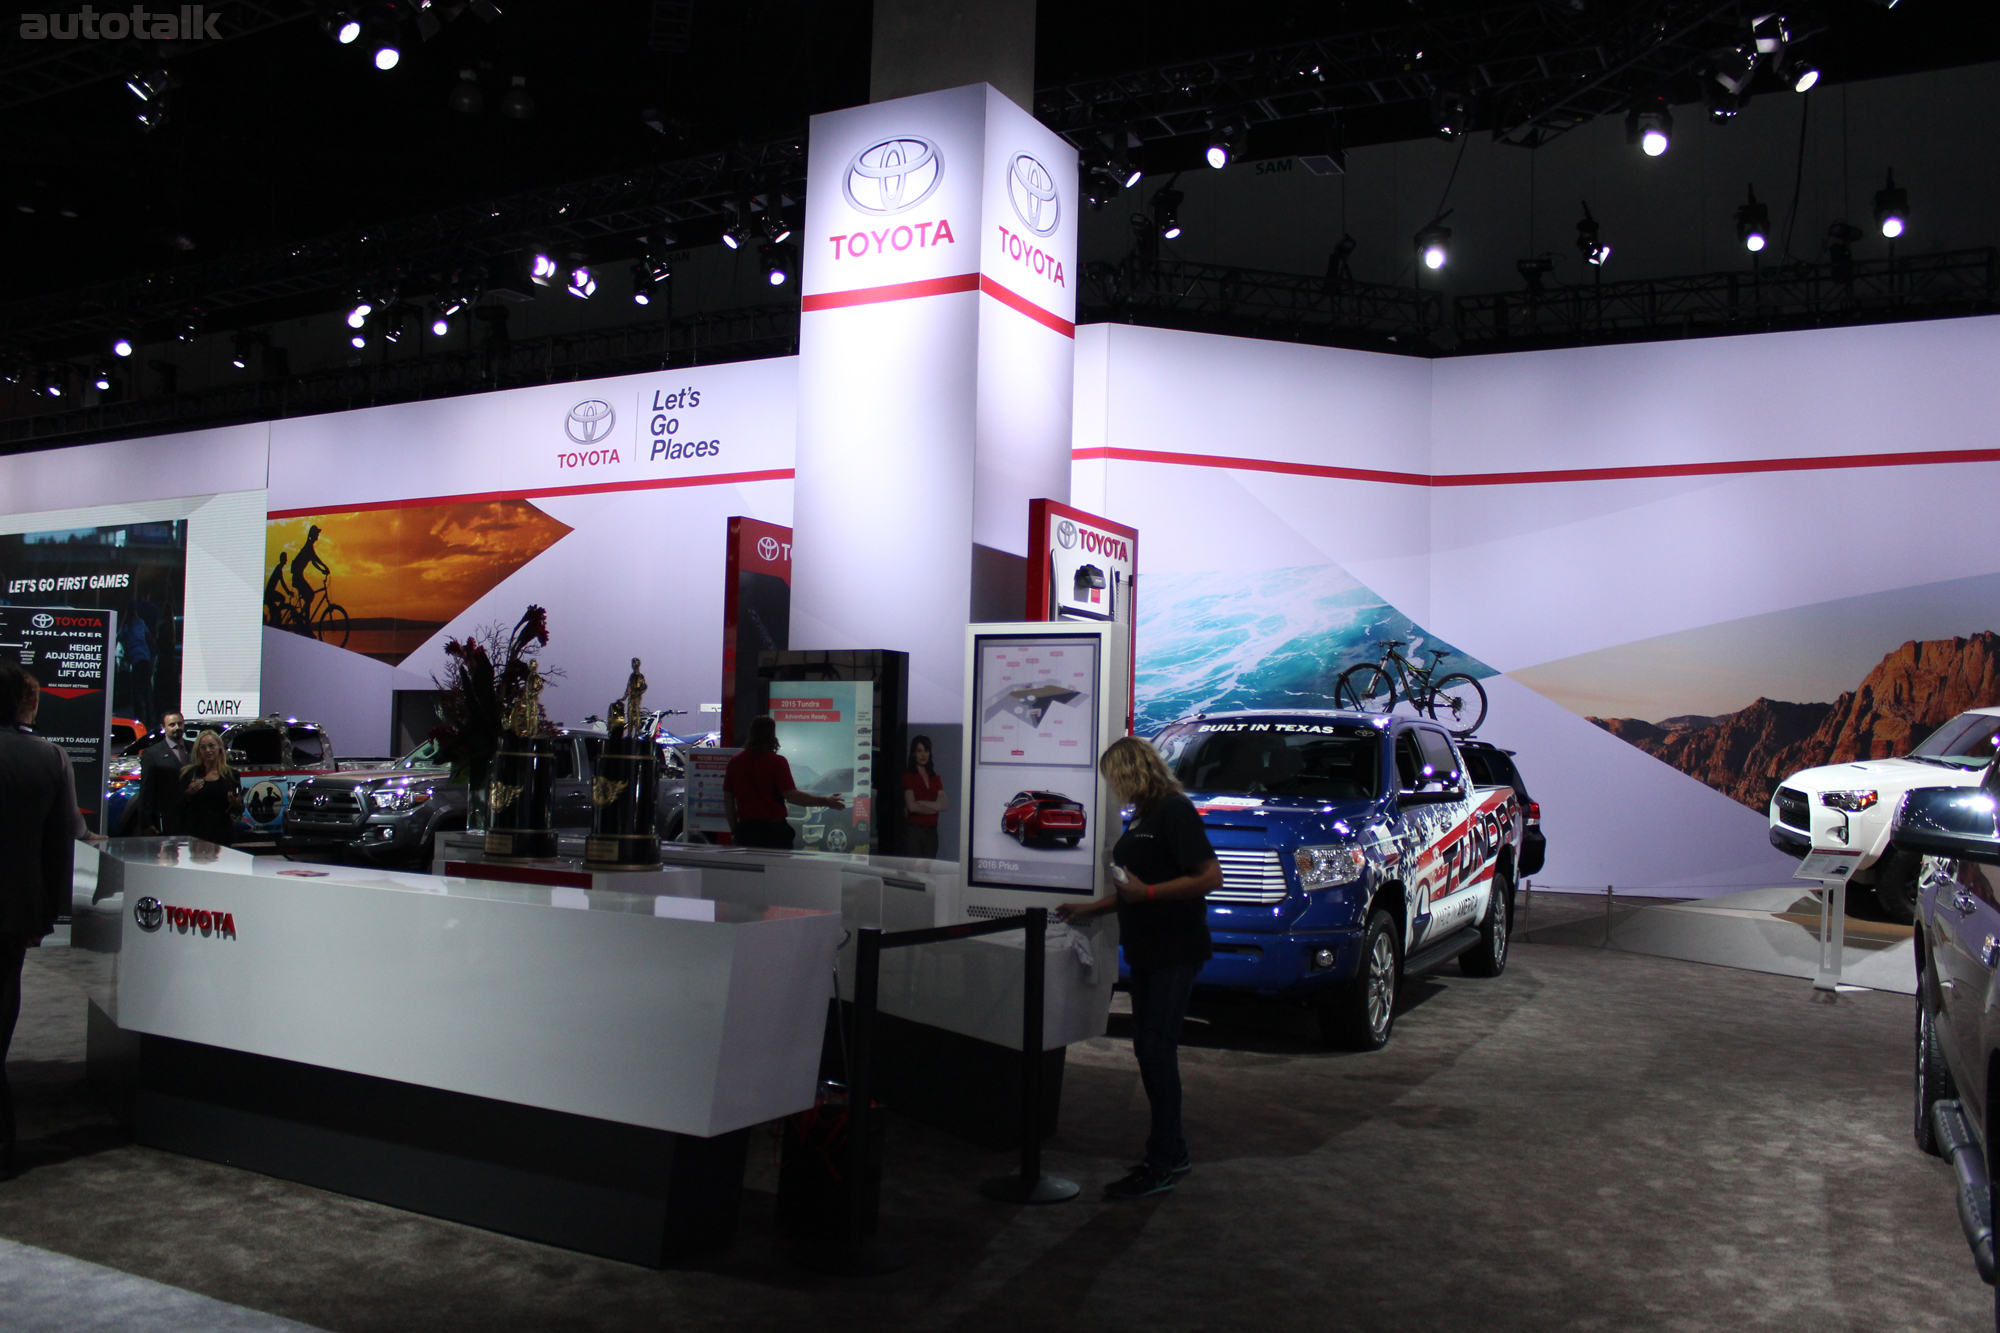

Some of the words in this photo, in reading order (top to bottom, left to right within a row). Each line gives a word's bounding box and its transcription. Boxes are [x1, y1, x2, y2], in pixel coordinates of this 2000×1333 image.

[829, 219, 955, 260] TOYOTA
[999, 225, 1066, 288] TOYOTA
[652, 387, 701, 411] Let's
[650, 414, 679, 436] Go
[557, 449, 620, 468] TOYOTA
[650, 439, 720, 461] Places
[781, 543, 793, 561] T
[1079, 529, 1128, 562] TOYOTA
[9, 579, 36, 593] LET'S
[38, 578, 55, 592] GO
[56, 576, 88, 591] FIRST
[89, 574, 129, 589] GAMES
[54, 617, 102, 627] TOYOTA
[21, 630, 103, 638] HIGHLANDER
[45, 652, 102, 660] ADJUSTABLE
[69, 644, 102, 652] HEIGHT
[61, 661, 102, 669] MEMORY
[78, 670, 101, 678] GATE
[197, 700, 242, 715] CAMRY
[1198, 723, 1248, 733] BUILT
[1250, 723, 1270, 732] IN
[1274, 723, 1335, 734] TEXAS
[978, 860, 997, 869] 2016
[998, 861, 1019, 871] Prius
[164, 905, 236, 934] TOYOTA
